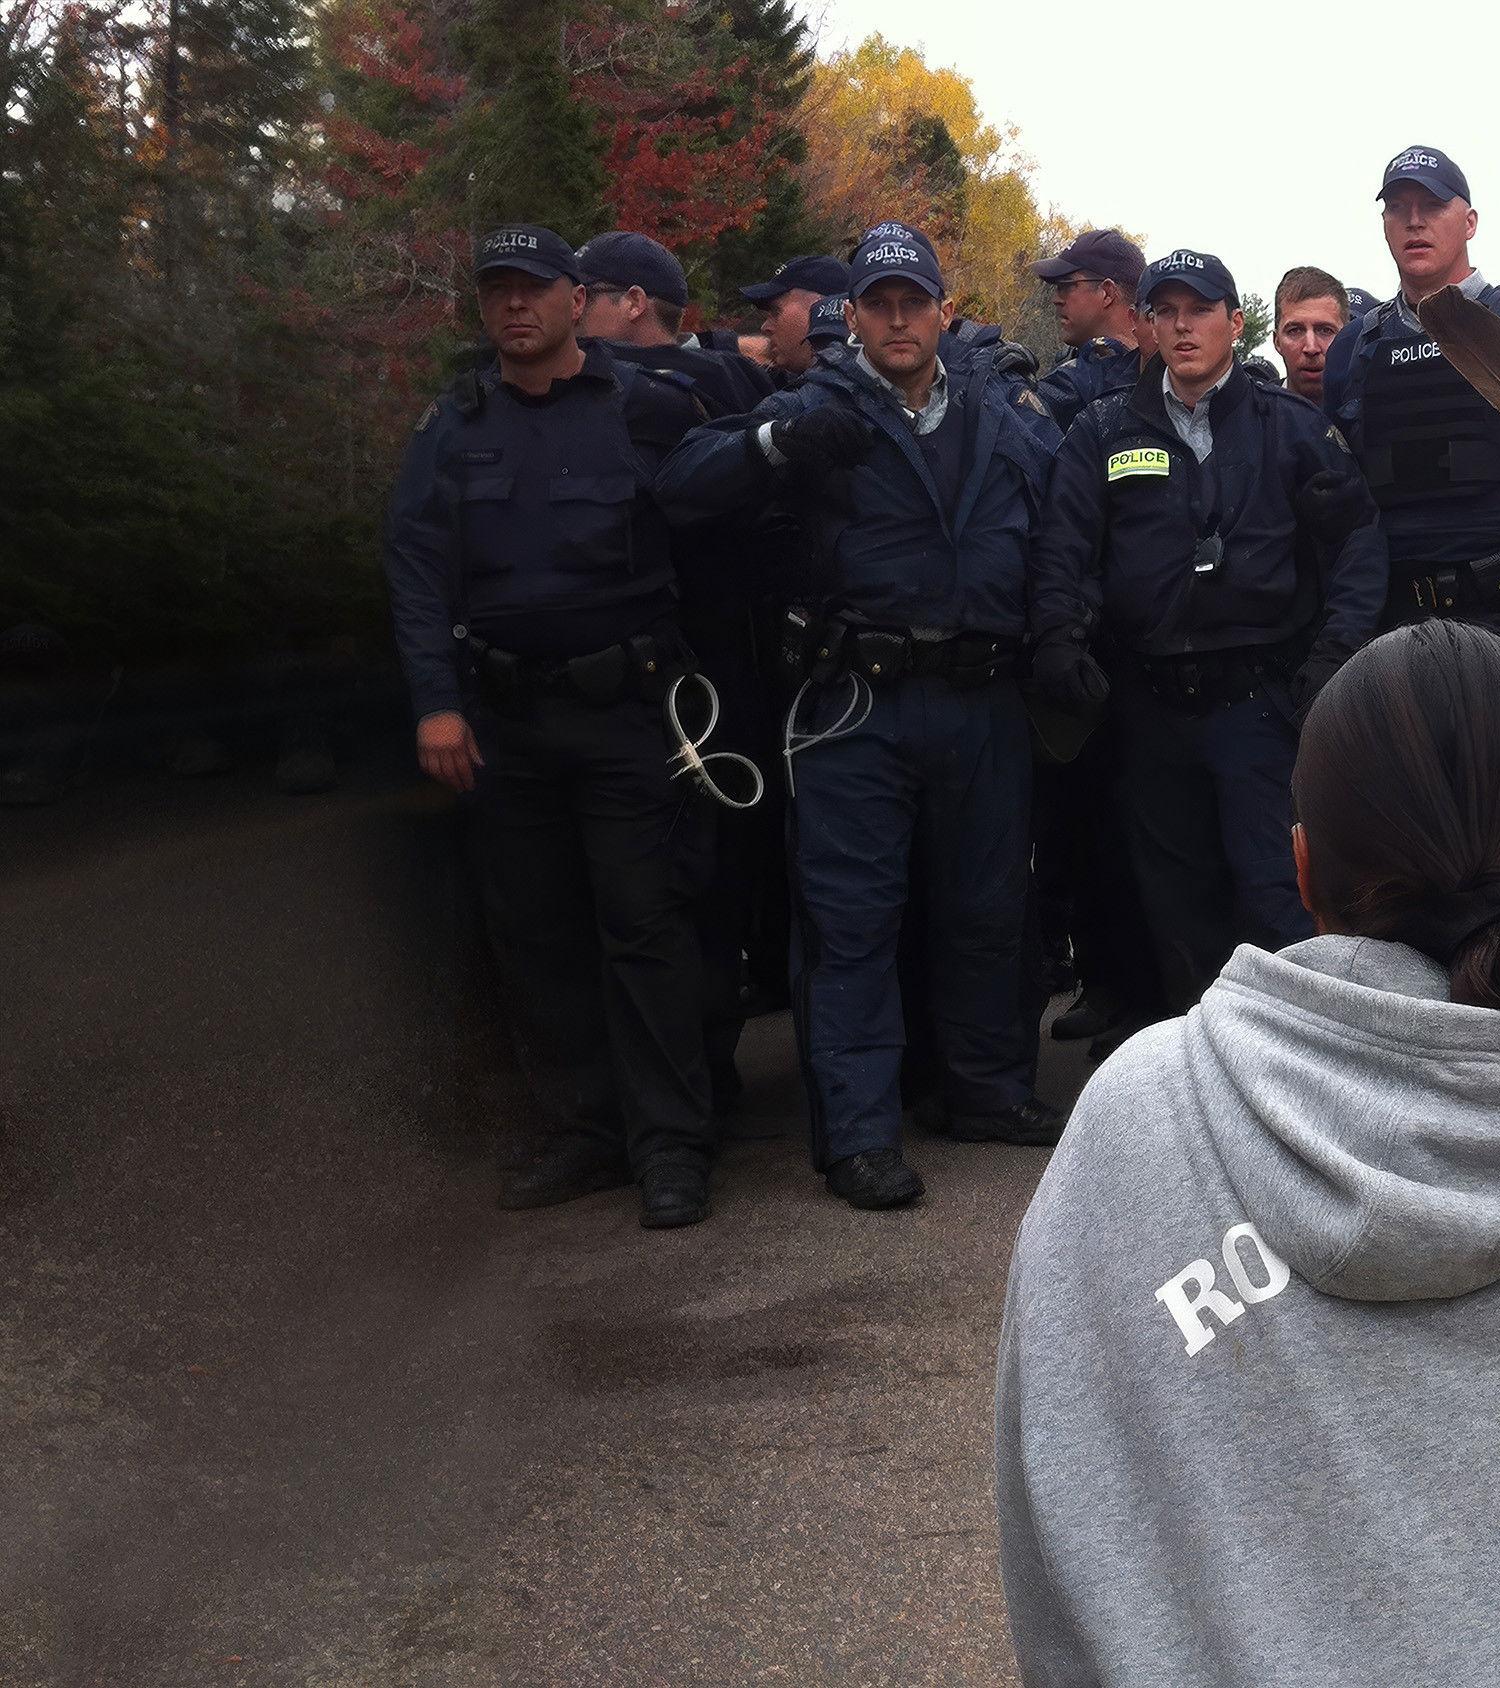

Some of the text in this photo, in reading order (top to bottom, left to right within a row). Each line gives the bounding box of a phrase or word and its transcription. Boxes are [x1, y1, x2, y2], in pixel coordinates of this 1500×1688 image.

[865, 245, 919, 265] POLICE
[1159, 252, 1204, 271] POLICE
[1391, 341, 1441, 365] POLICE
[1110, 451, 1167, 469] POLICE
